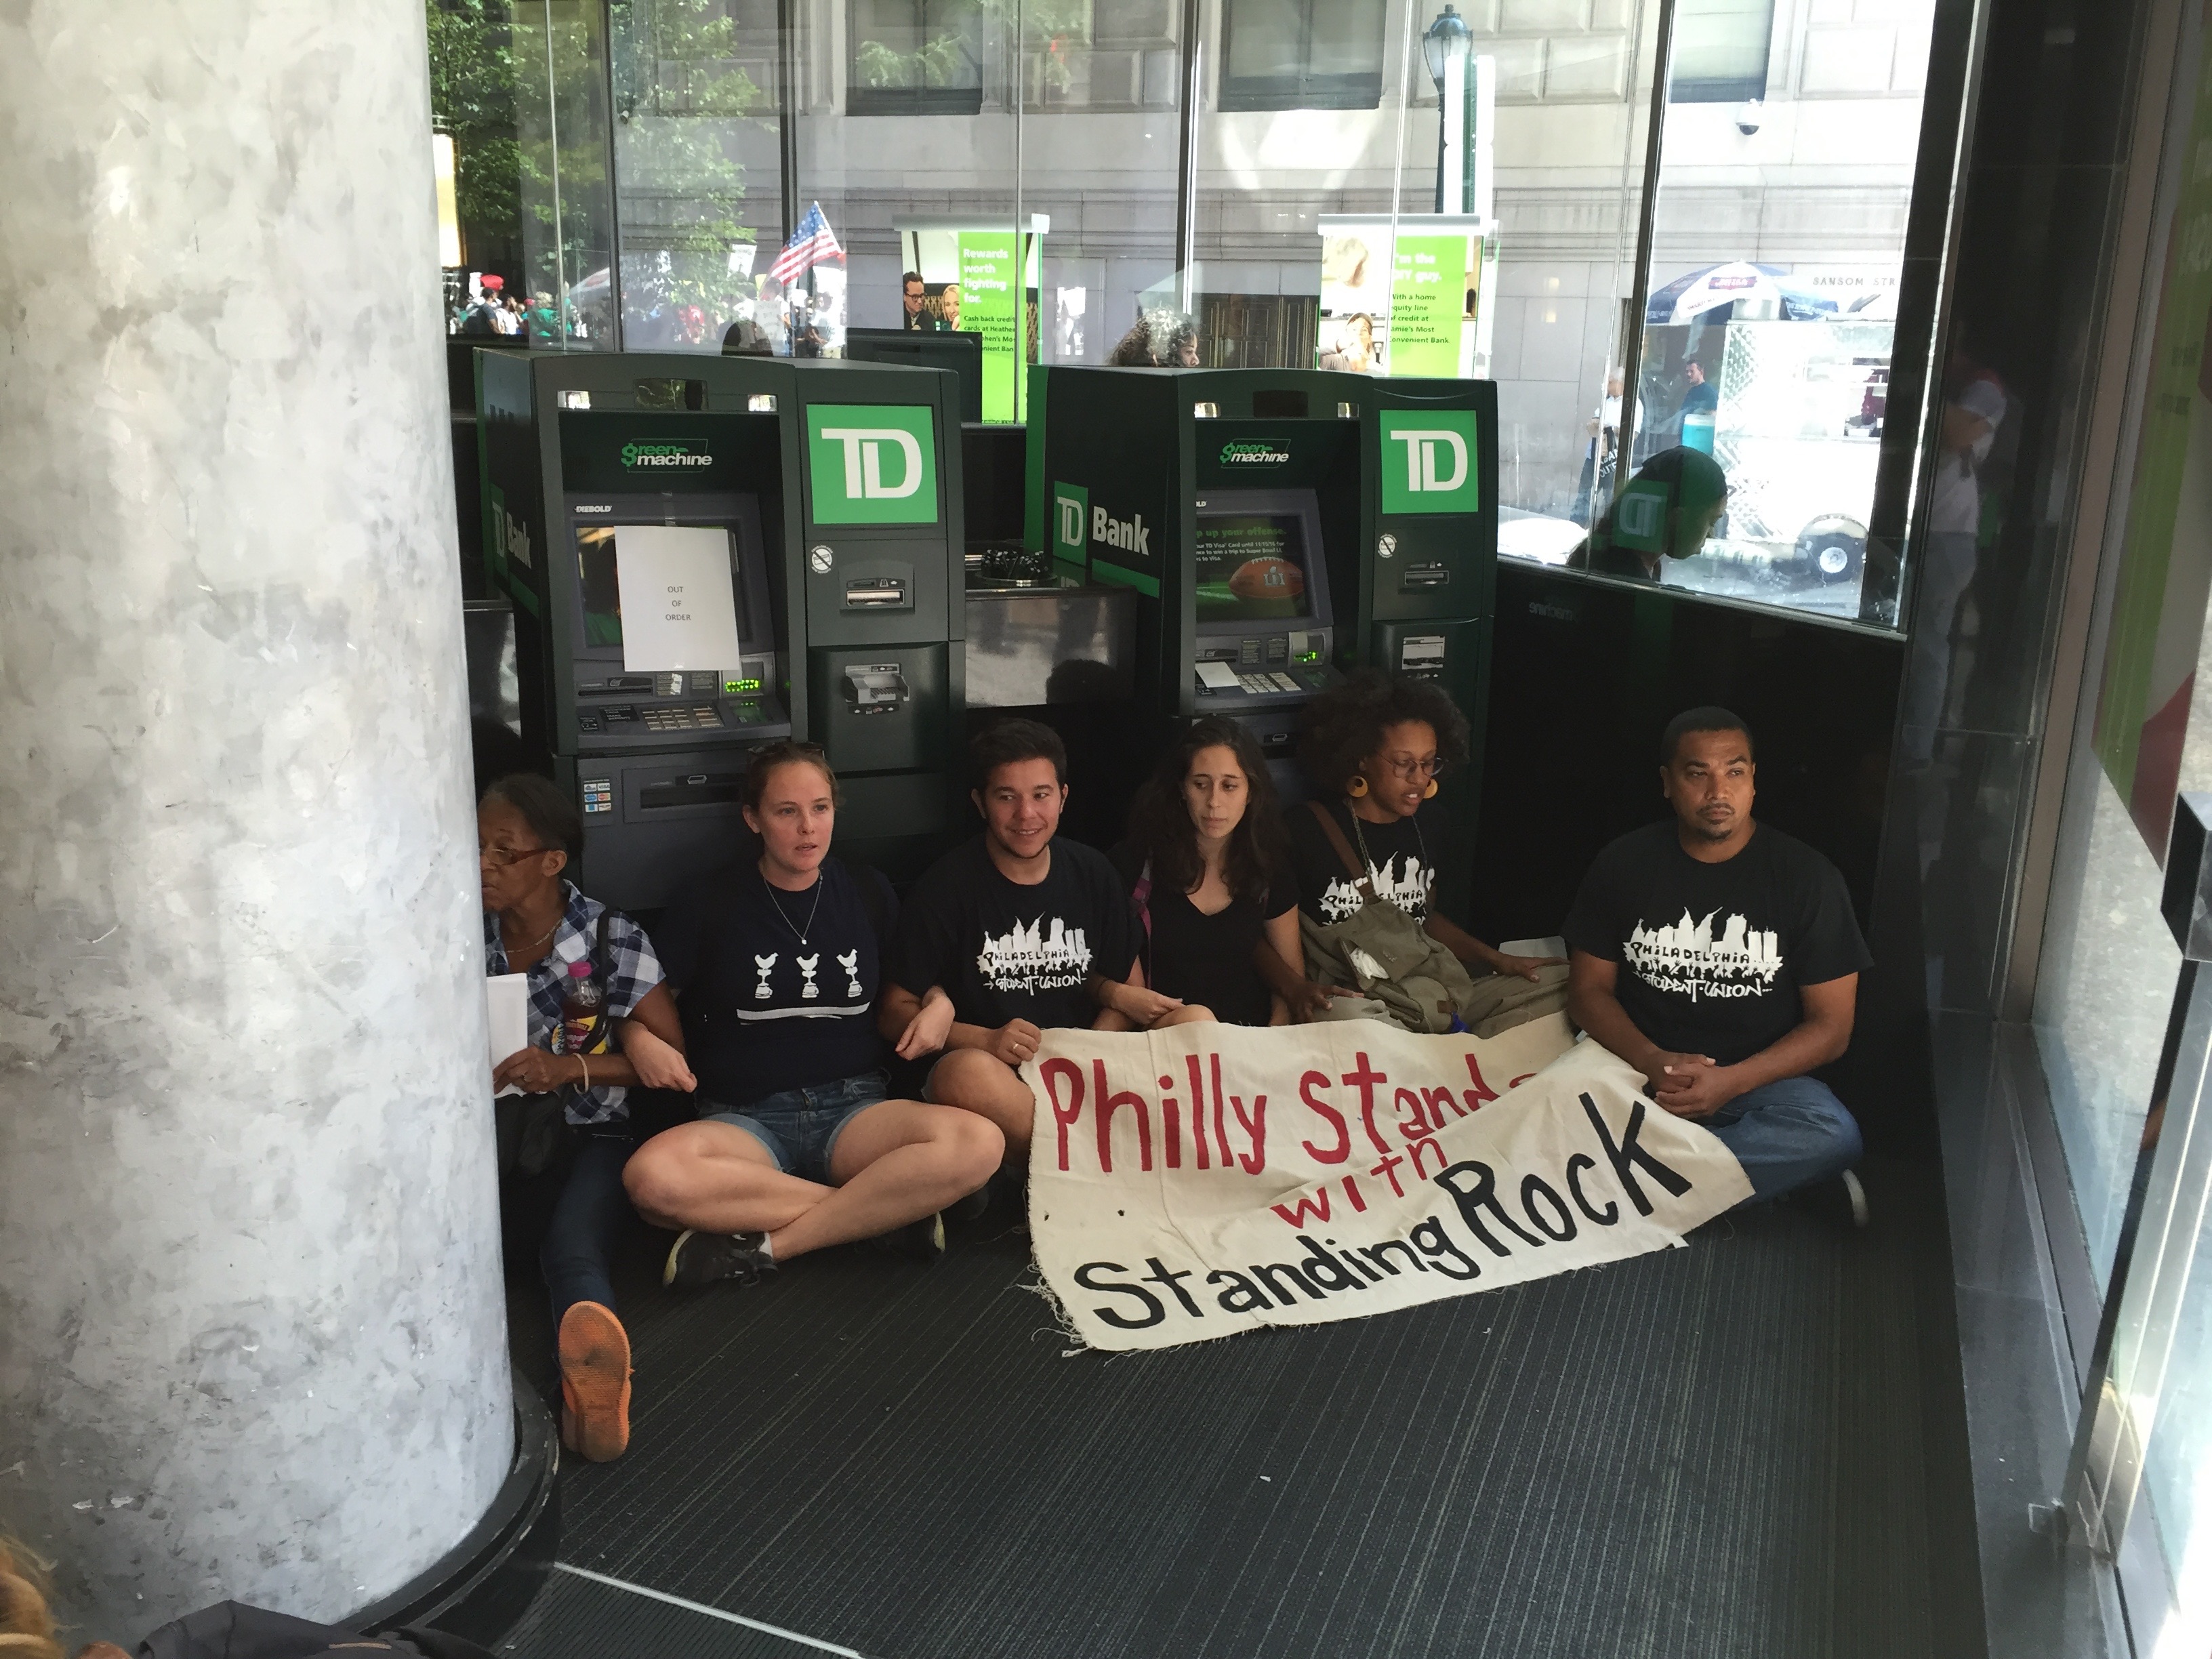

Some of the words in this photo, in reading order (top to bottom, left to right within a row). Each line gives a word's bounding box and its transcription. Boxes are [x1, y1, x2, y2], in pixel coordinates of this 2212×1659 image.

[963, 248, 1008, 259] Rewards
[963, 263, 996, 273] worth
[964, 278, 1007, 291] fighting
[1814, 276, 1864, 286] SANSOM
[1873, 276, 1902, 286] STR
[964, 292, 982, 304] for.
[637, 453, 713, 466] machine
[1230, 451, 1289, 462] machine
[1389, 430, 1469, 491] TD
[821, 428, 923, 499] TD
[1057, 496, 1084, 547] TD
[1092, 506, 1150, 556] Bank
[1206, 529, 1218, 538] up
[1221, 529, 1244, 538] your
[1247, 527, 1287, 536] offense.
[667, 586, 684, 594] OUT
[1039, 1052, 1268, 1176] Philly
[1073, 1216, 1481, 1330] Standing
